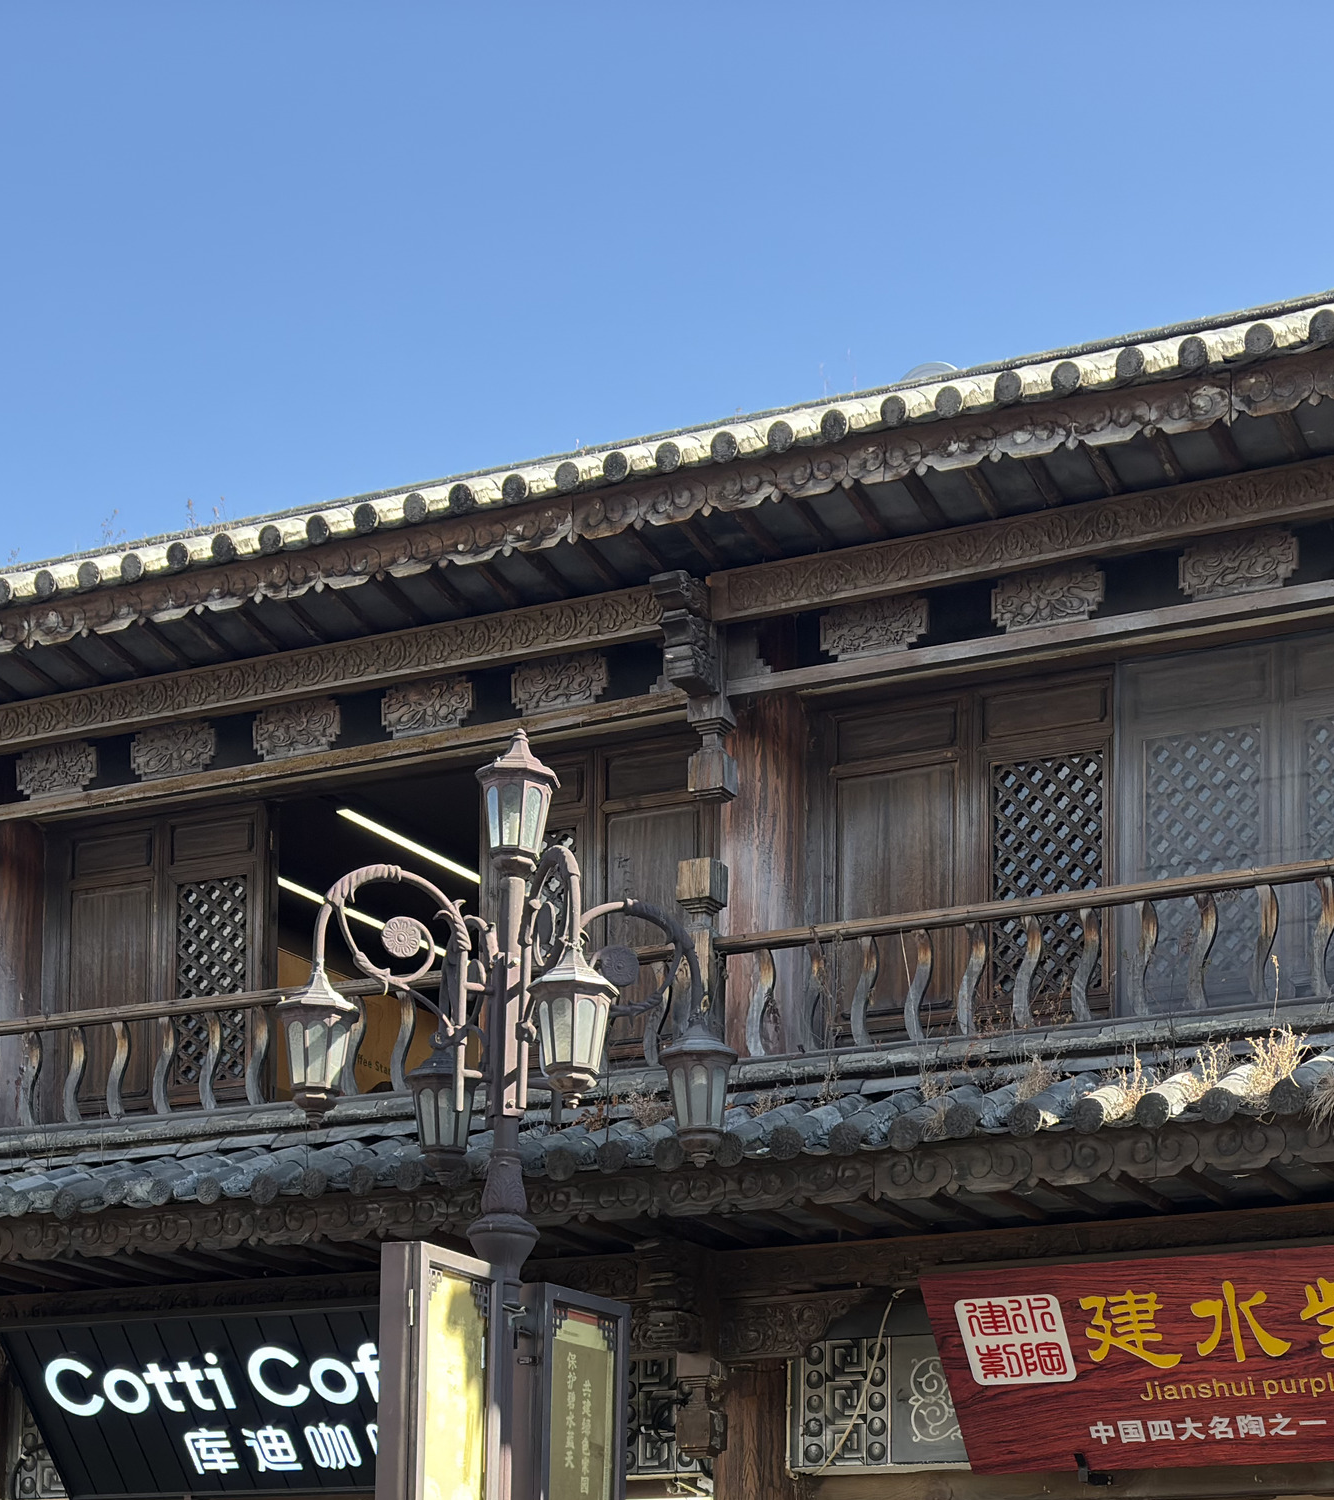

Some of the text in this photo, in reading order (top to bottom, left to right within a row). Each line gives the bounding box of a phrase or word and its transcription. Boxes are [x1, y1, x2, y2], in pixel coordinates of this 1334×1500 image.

[45, 1352, 237, 1417] Cotti
[1140, 1375, 1257, 1401] Jianshui
[1089, 1411, 1328, 1445] 中国四大名陶之一
